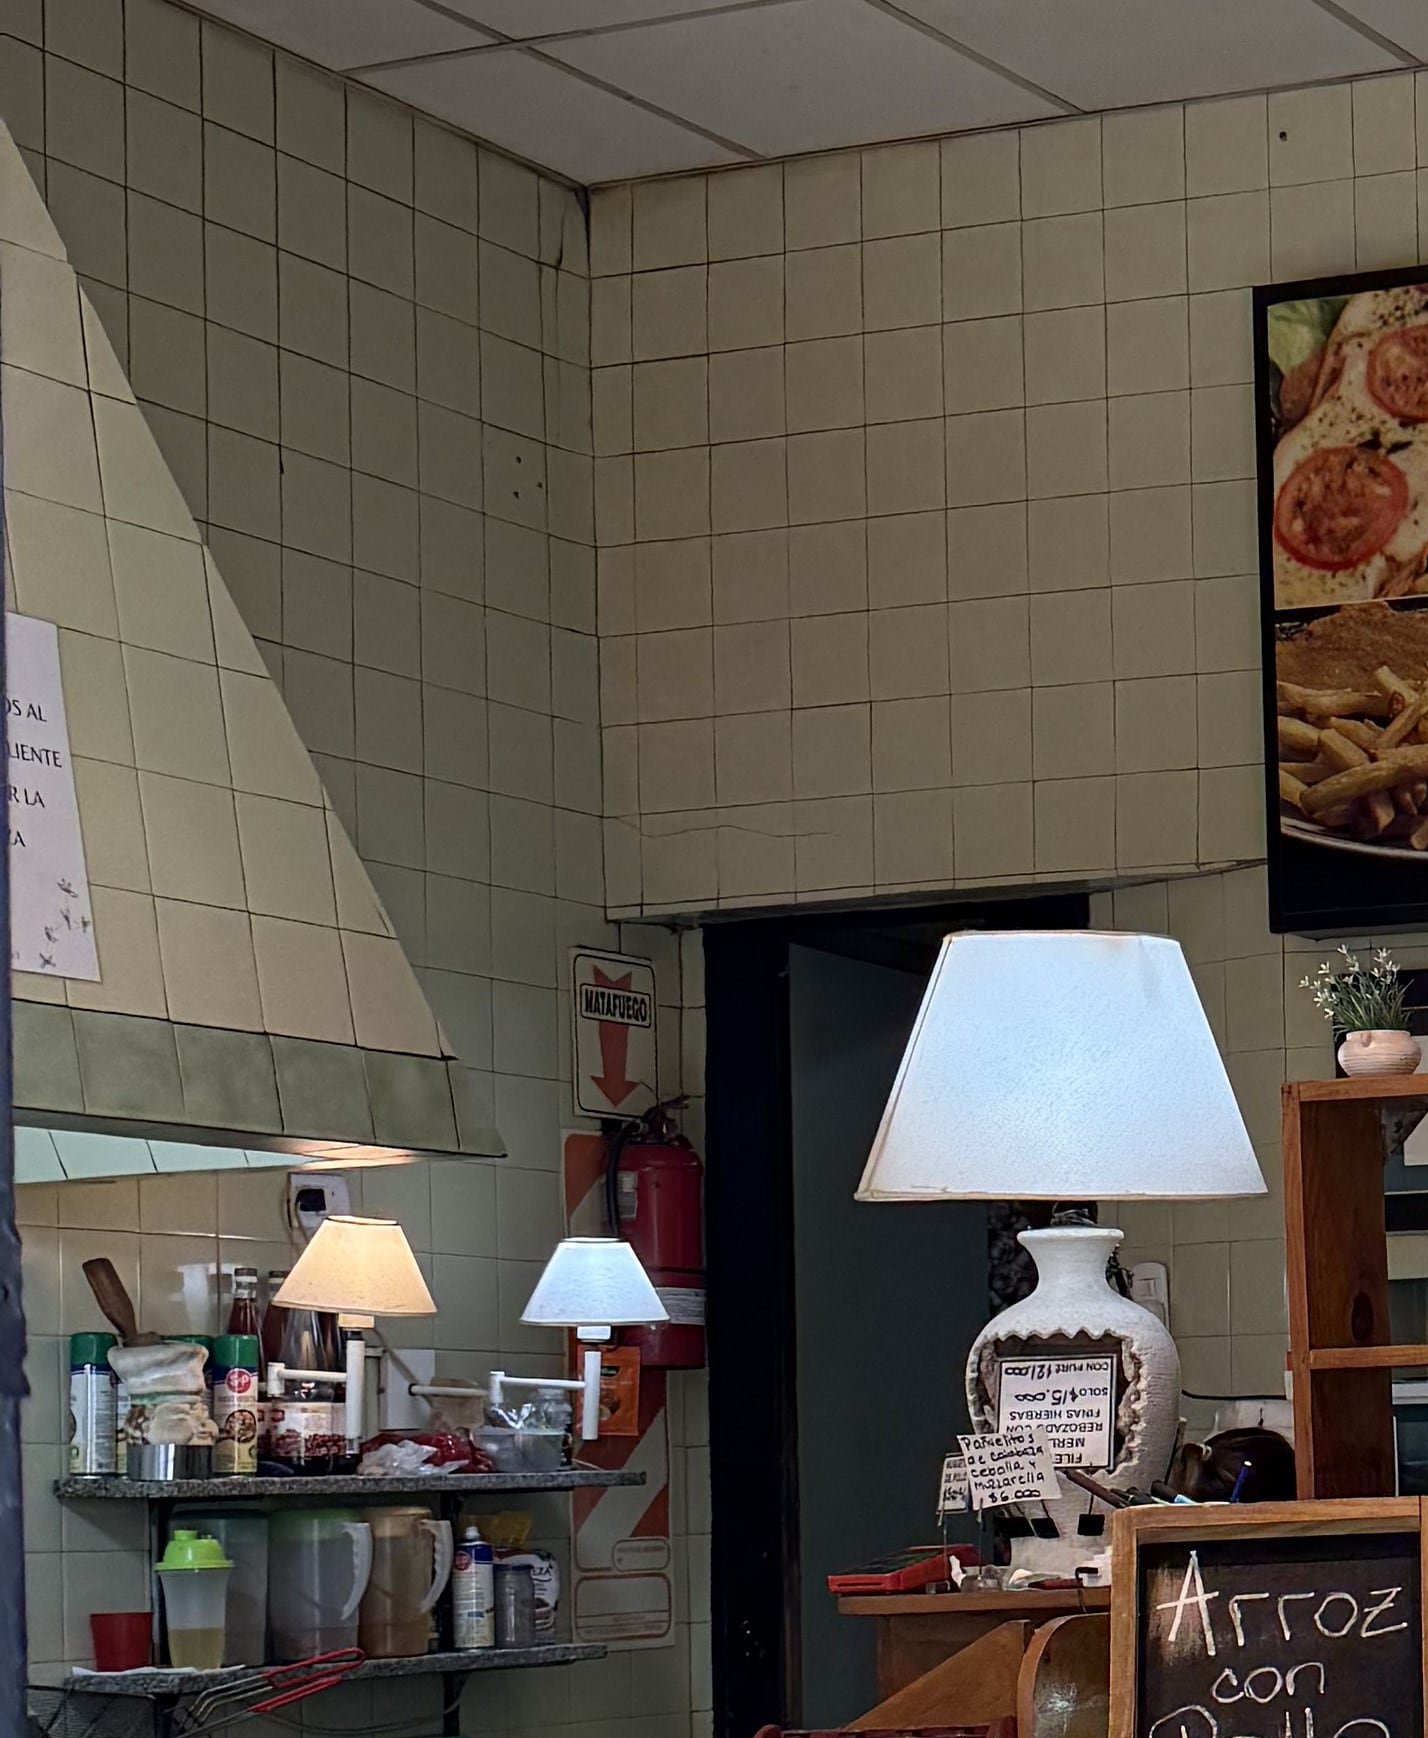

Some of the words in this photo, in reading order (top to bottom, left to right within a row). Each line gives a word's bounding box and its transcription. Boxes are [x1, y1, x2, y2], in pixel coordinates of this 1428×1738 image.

[27, 704, 47, 722] AL
[24, 788, 45, 808] LA
[584, 988, 647, 1022] MATAFUEGO
[1087, 1362, 1109, 1371] CON
[1015, 1387, 1079, 1405] $15.000
[1080, 1387, 1108, 1396] SOLO
[1009, 1410, 1062, 1420] HIERBAS
[1048, 1438, 1085, 1448] MERL
[1052, 1453, 1082, 1464] FILE
[971, 1461, 1024, 1478] cebolla
[1156, 1551, 1407, 1656] Arroz
[1212, 1662, 1325, 1703] con
